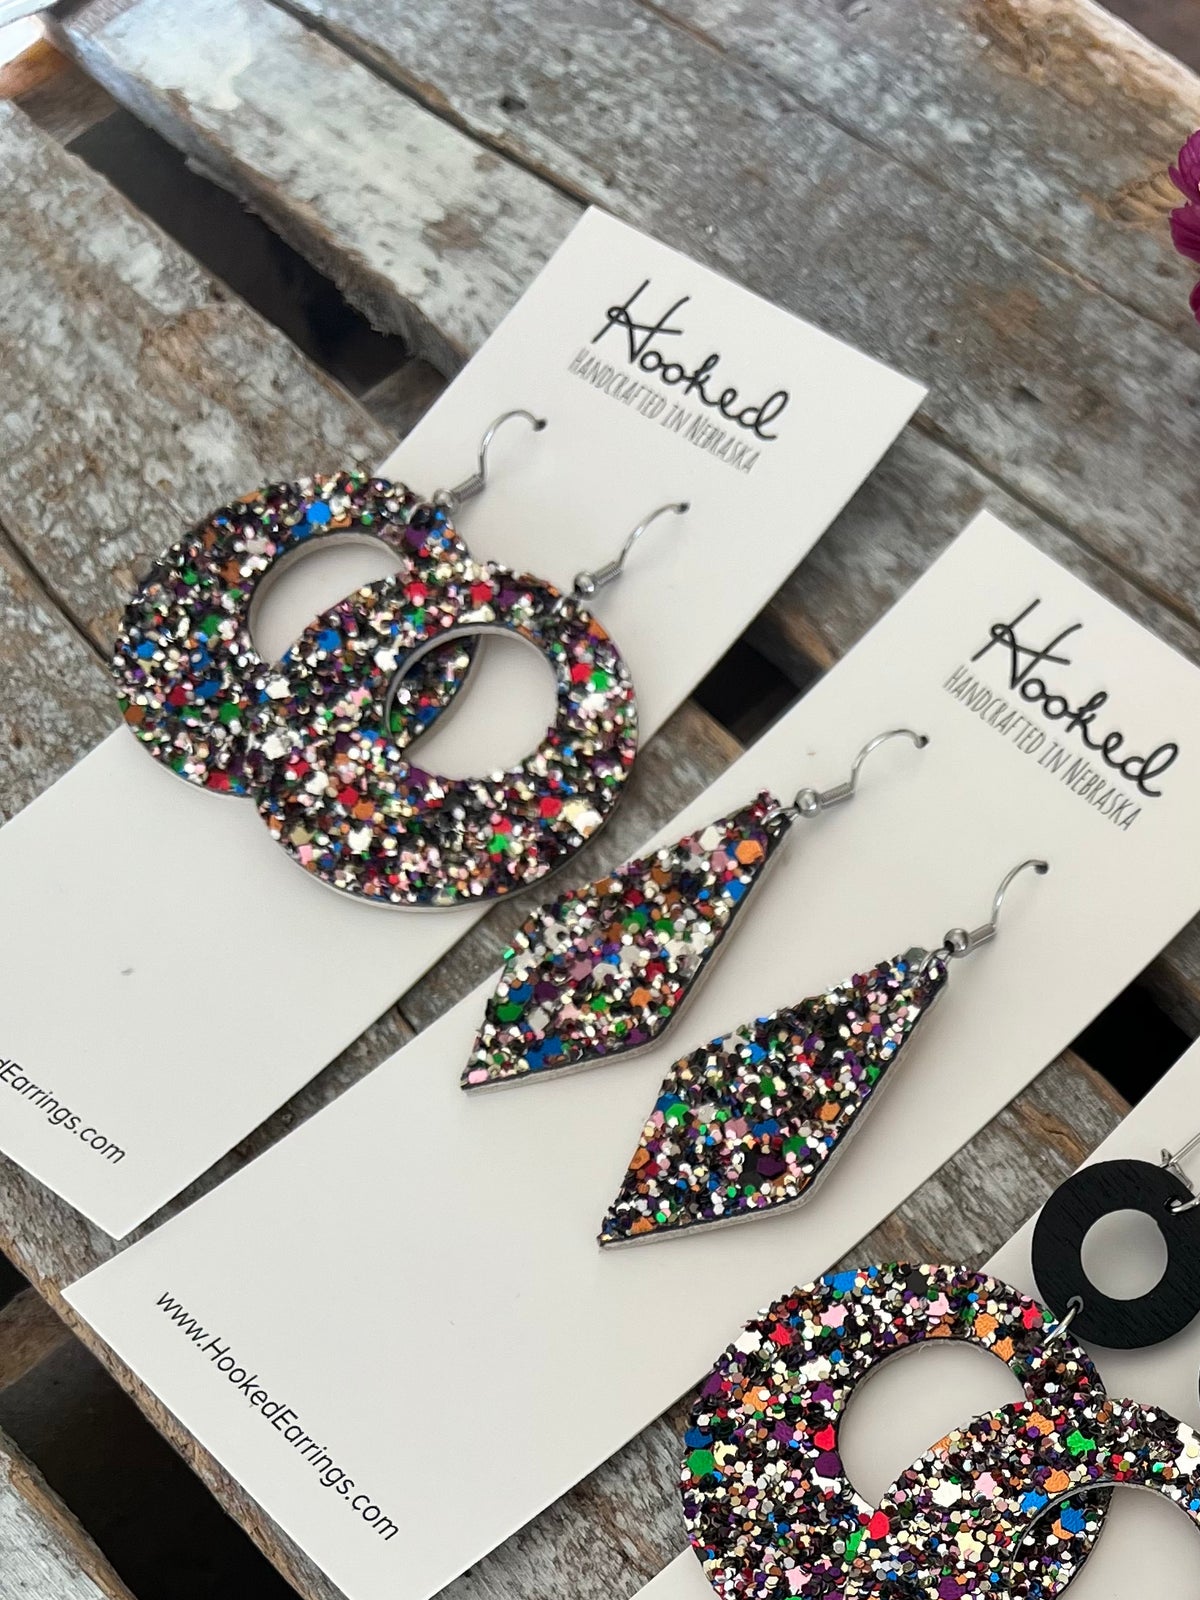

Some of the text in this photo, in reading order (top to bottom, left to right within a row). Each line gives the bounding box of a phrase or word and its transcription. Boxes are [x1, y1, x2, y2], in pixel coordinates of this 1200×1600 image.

[591, 279, 788, 440] Hooked
[942, 664, 1048, 755] HANDCRAFTED
[1037, 741, 1072, 773] IN
[971, 598, 1178, 797] Hooked
[156, 1291, 399, 1541] www.HookedEarrings.com
